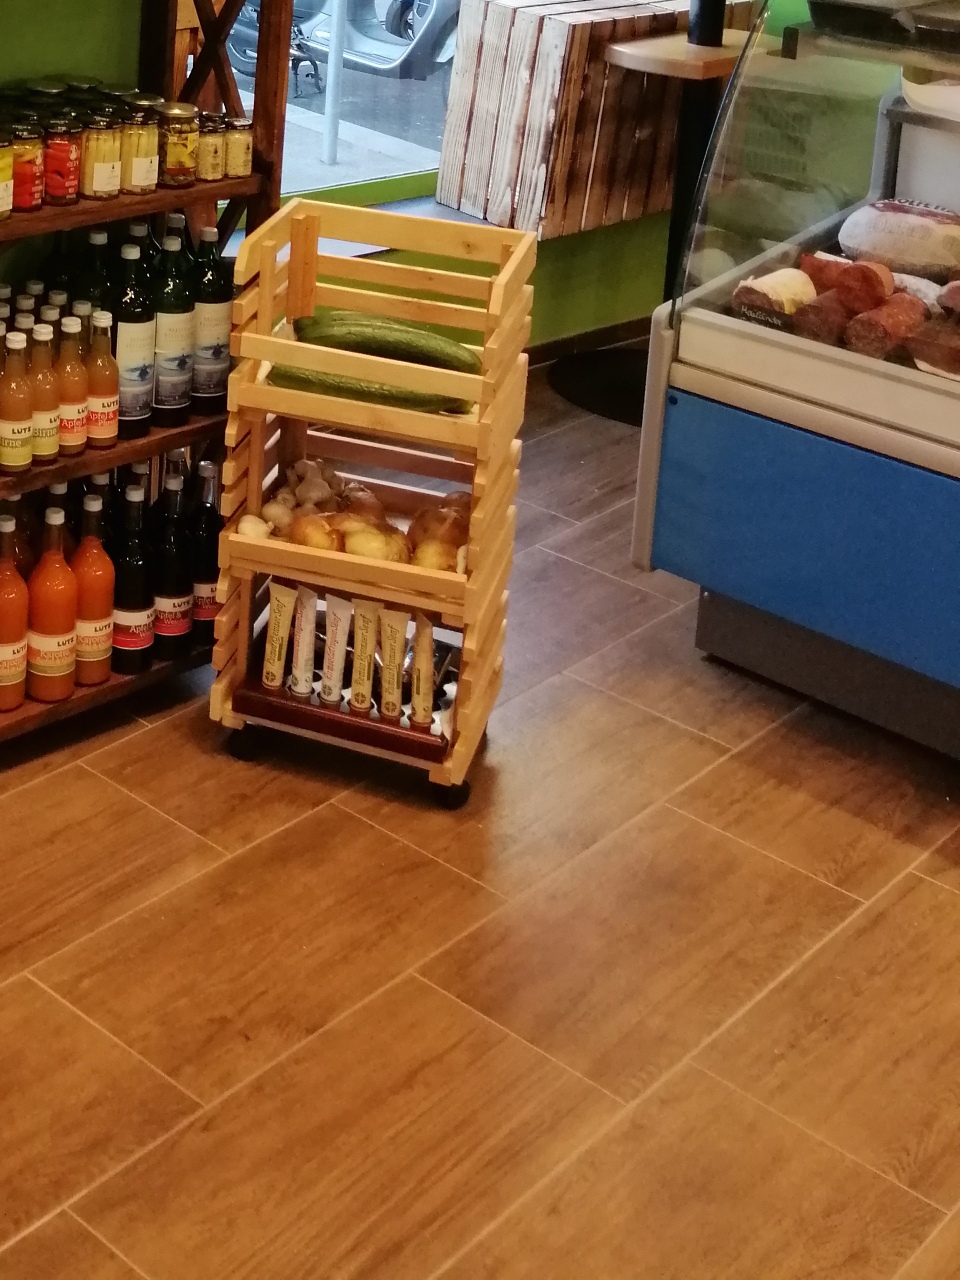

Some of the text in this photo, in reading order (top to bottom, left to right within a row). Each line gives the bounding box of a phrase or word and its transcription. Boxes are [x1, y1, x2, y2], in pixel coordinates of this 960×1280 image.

[0, 438, 22, 448] irne
[274, 597, 286, 617] Senf
[93, 622, 111, 633] LUTZ
[359, 613, 372, 631] Senf
[387, 623, 400, 641] Senf
[57, 636, 75, 647] LUTZ
